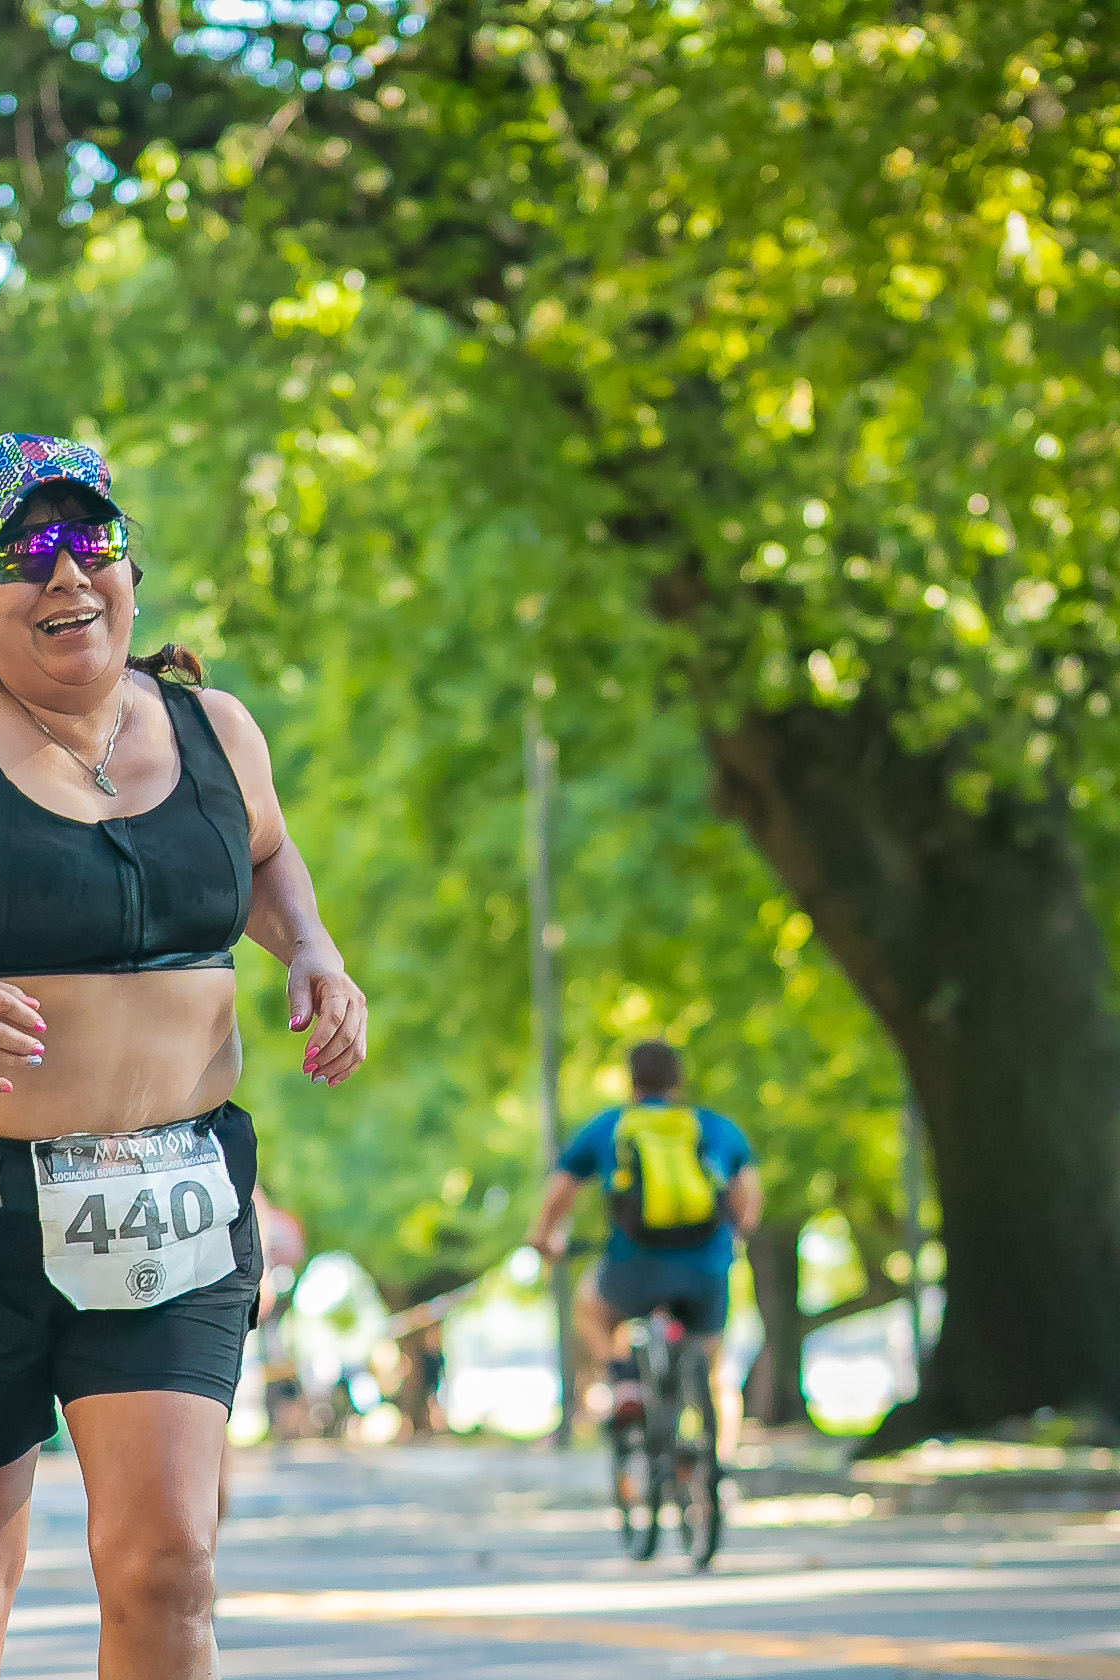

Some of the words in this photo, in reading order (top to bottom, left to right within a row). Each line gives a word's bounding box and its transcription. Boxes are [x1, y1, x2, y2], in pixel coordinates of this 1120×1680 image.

[97, 1163, 143, 1179] BOMBEROS
[184, 1152, 217, 1167] ROSARIO
[65, 1180, 214, 1254] 440
[139, 1272, 157, 1288] 27
